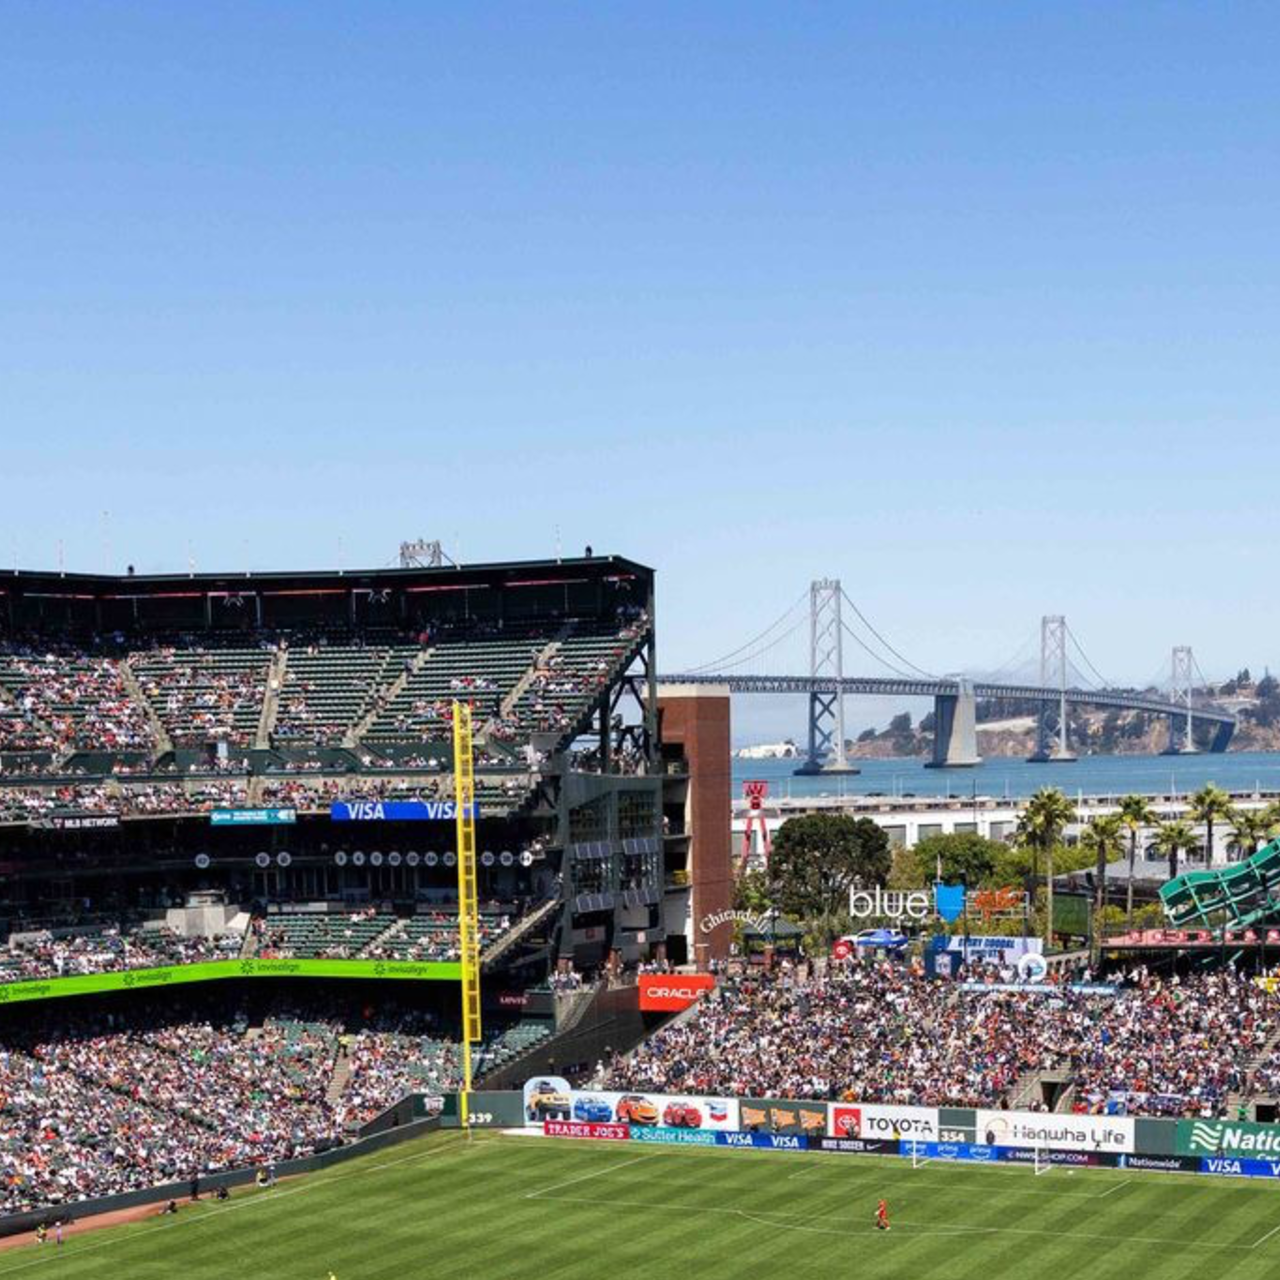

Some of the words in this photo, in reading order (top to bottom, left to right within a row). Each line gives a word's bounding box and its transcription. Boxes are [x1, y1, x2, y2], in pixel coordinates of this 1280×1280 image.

[344, 803, 386, 820] VISA
[64, 819, 82, 829] MLB
[82, 817, 118, 828] NETWORK
[848, 884, 929, 918] blue
[647, 986, 708, 1000] ORACLE
[467, 1113, 493, 1124] 339
[867, 1117, 933, 1134] TOYOTA
[547, 1124, 590, 1137] TRADER
[593, 1125, 624, 1138] JOE'S
[641, 1129, 675, 1142] Sutter
[677, 1131, 716, 1145] Health
[1013, 1123, 1086, 1143] Hanwha
[1091, 1126, 1126, 1145] Life
[725, 1133, 754, 1146] VISA
[770, 1135, 800, 1148] VISA
[840, 1140, 865, 1151] SOCCER
[1128, 1156, 1181, 1169] Nationwide
[1207, 1158, 1242, 1174] VISA
